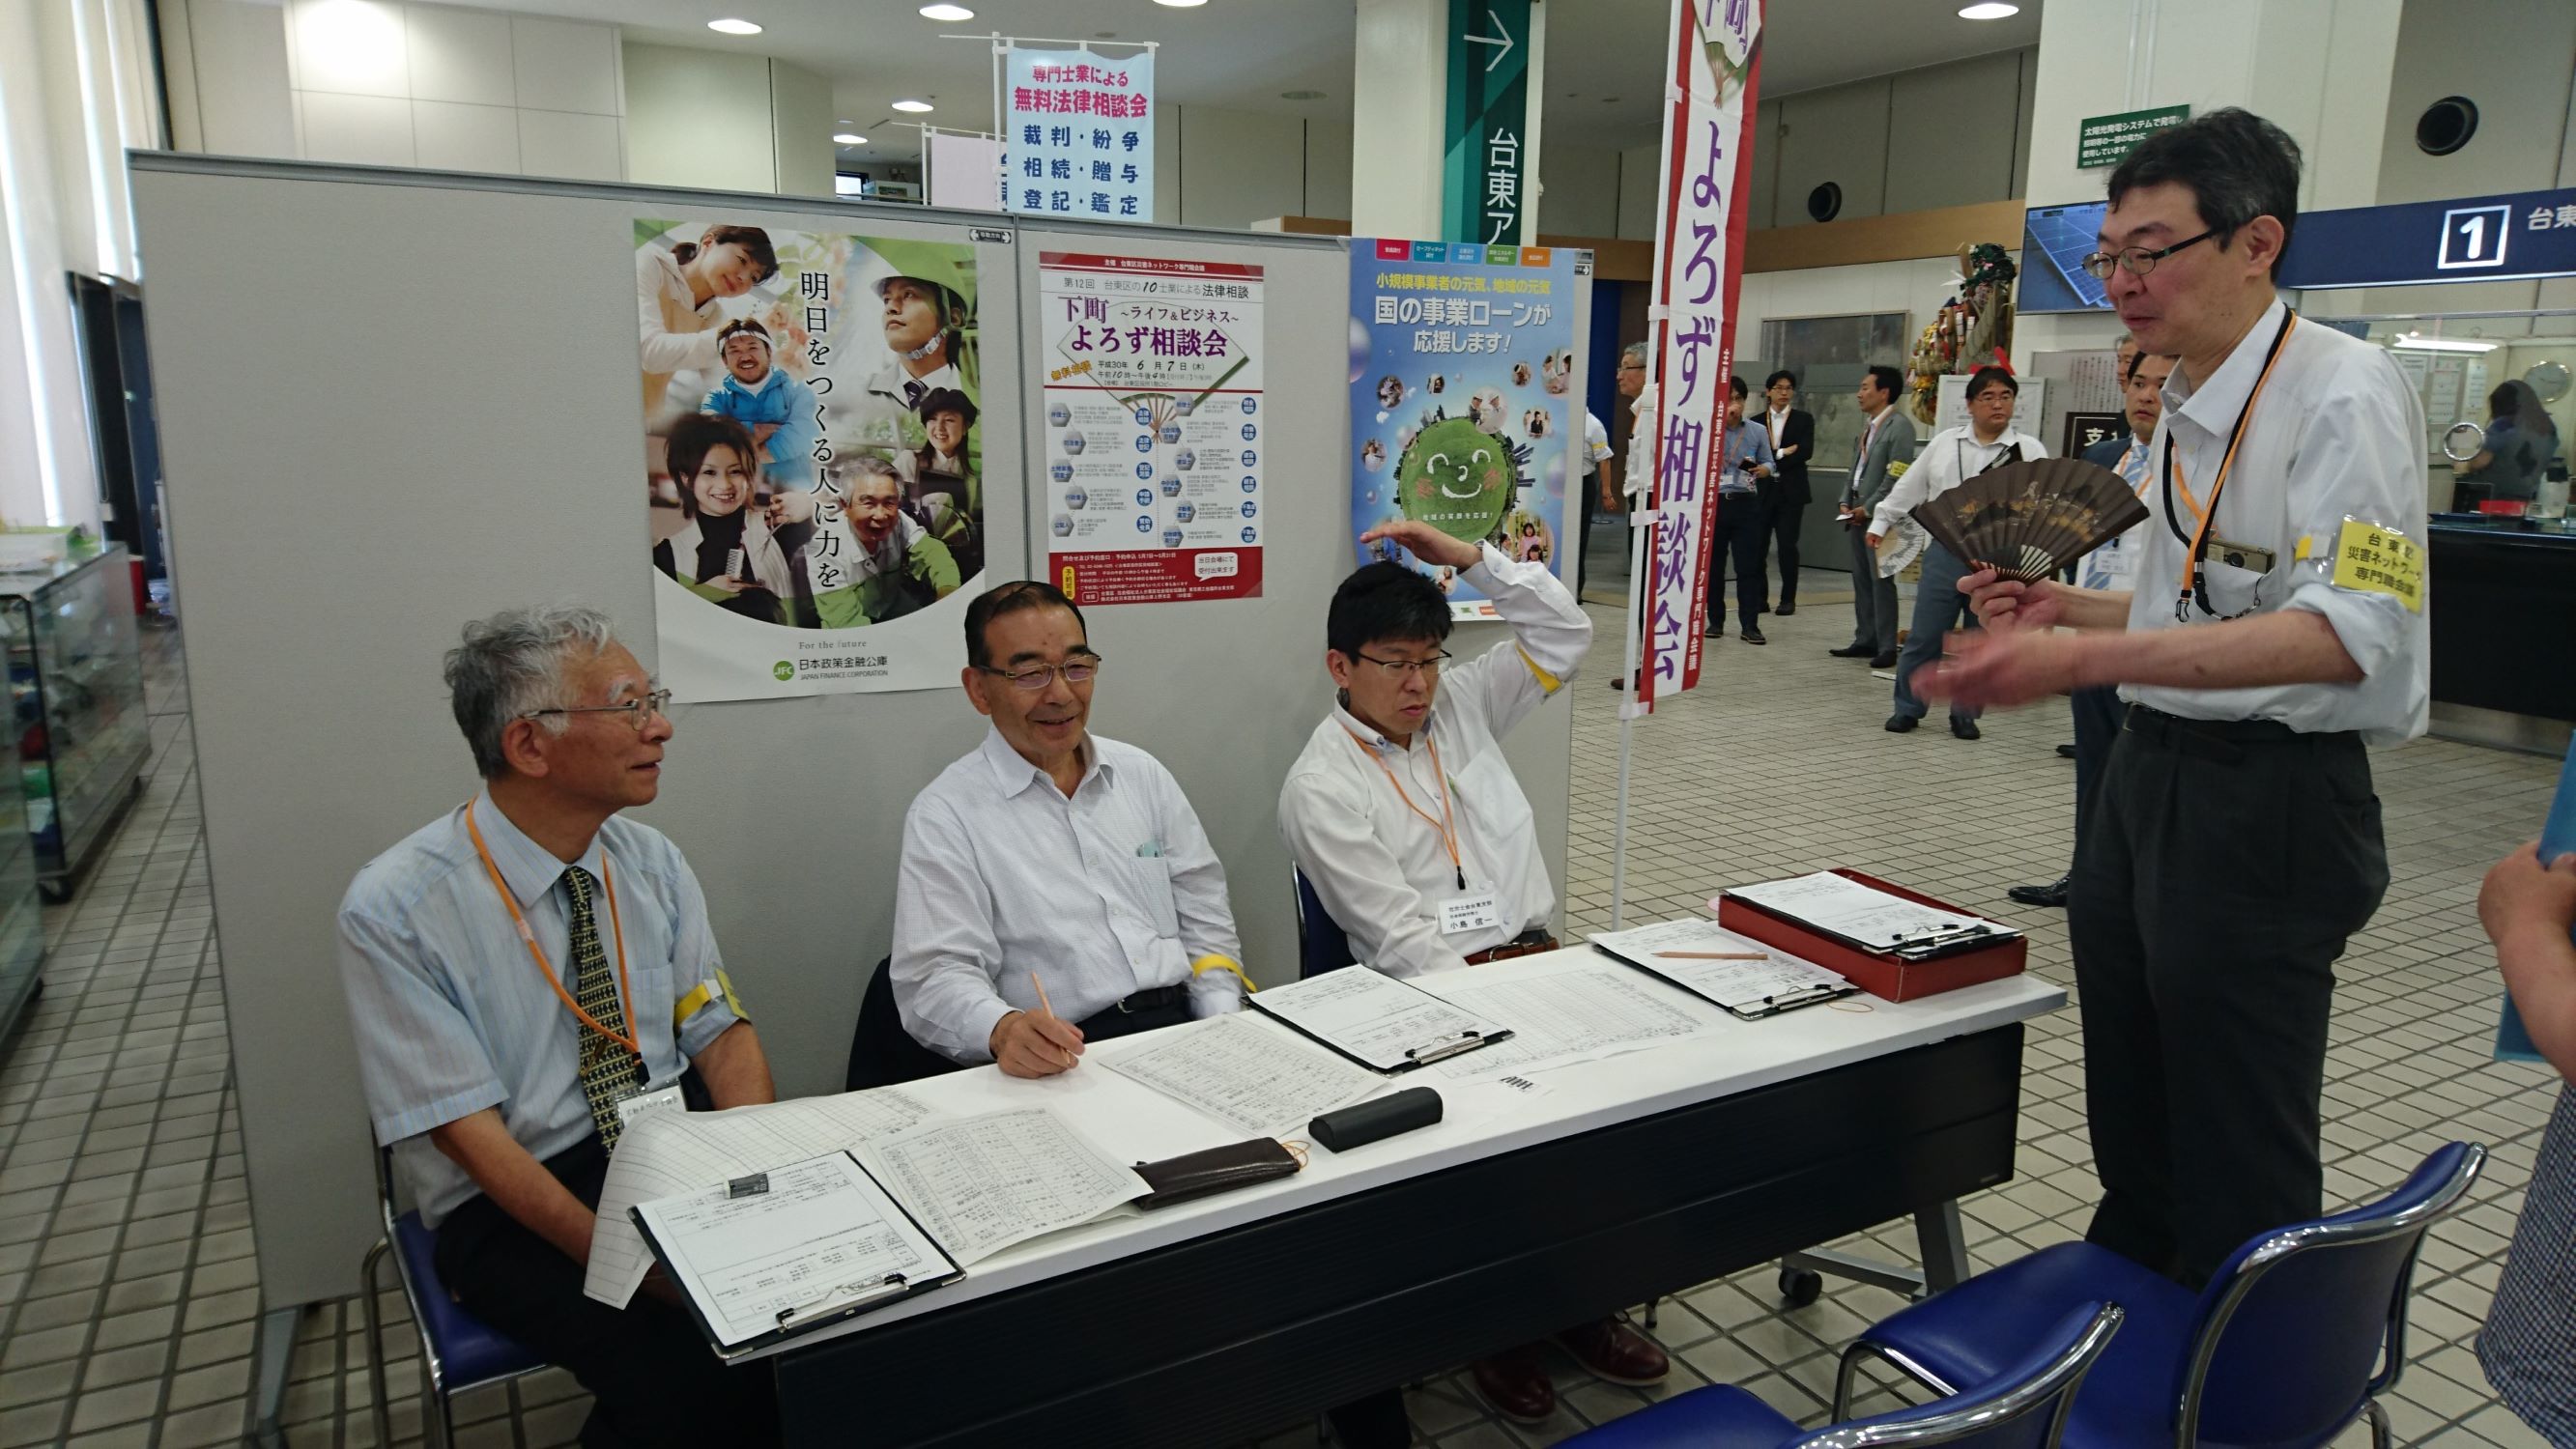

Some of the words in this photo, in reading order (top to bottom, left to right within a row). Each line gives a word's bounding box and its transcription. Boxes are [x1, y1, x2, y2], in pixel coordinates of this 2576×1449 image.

[1032, 65, 1129, 87] 専門士業による
[1014, 86, 1148, 118] 無料法律相談会
[1486, 128, 1519, 244] 台東ア
[2459, 214, 2485, 260] 1
[1064, 277, 1095, 290] 第12回
[1058, 295, 1109, 325] 下町
[1375, 296, 1553, 327] 国の事業ローンが
[1071, 325, 1228, 358] よろず相談会
[1413, 329, 1512, 355] 応援します!
[1653, 120, 1722, 680] よろず相談会
[800, 270, 843, 588] 明日をつくる人に力を
[818, 640, 834, 649] the
[837, 639, 867, 648] future
[799, 656, 888, 670] 日本政策金融公庫
